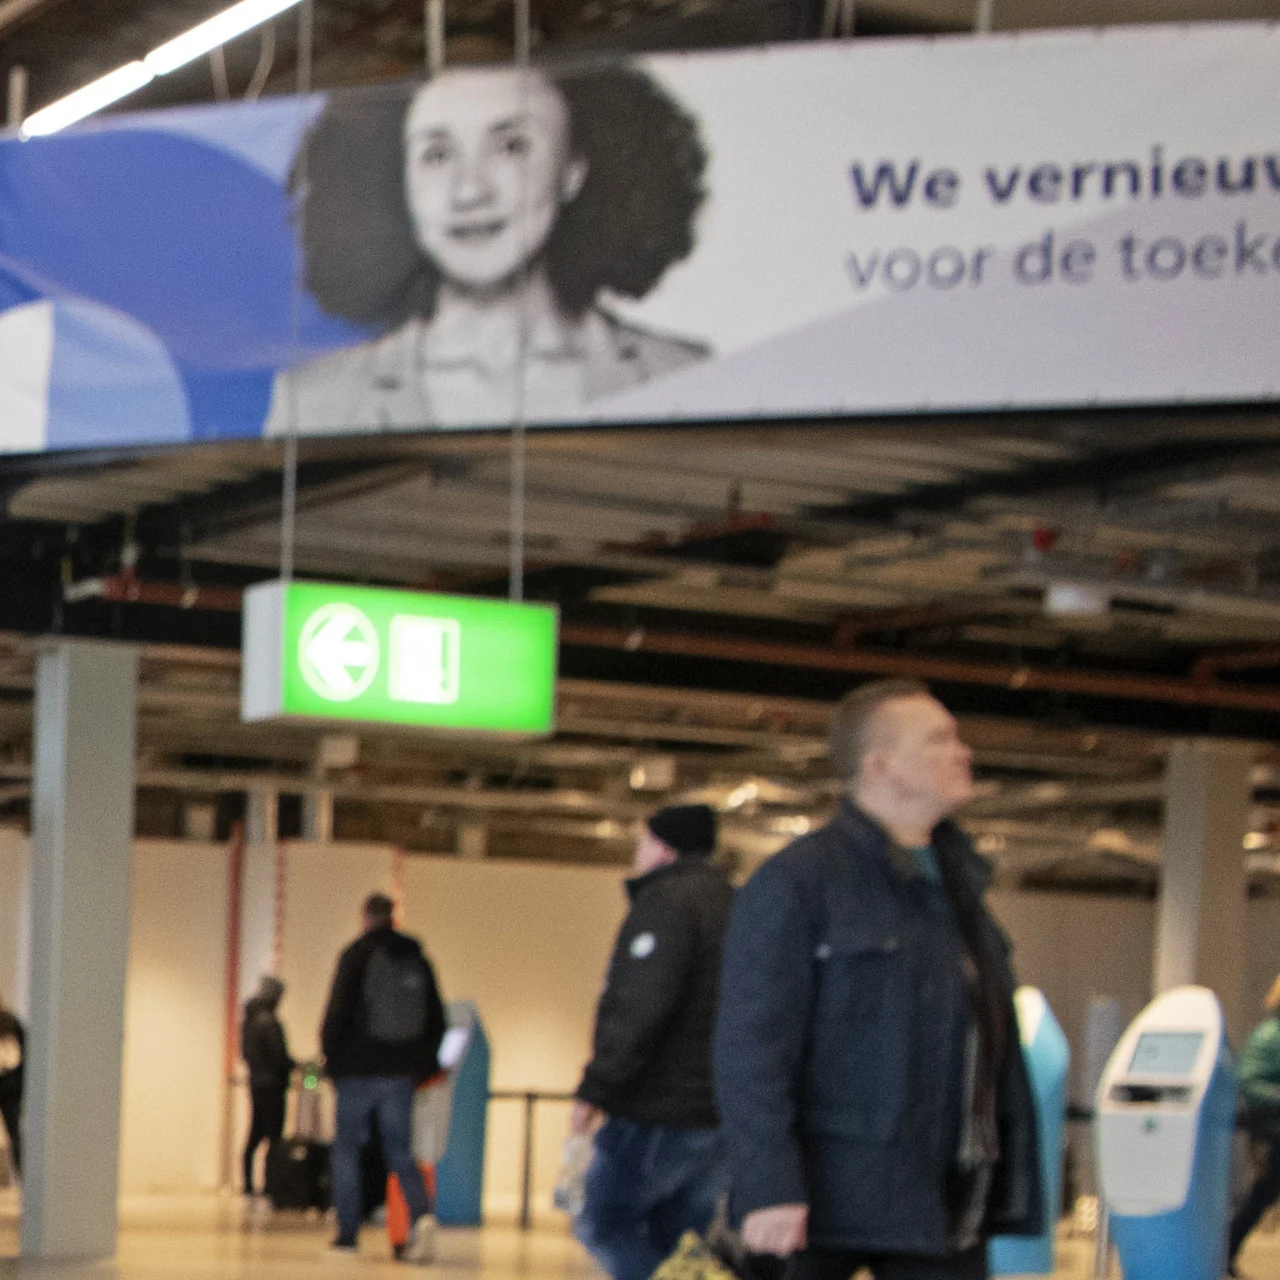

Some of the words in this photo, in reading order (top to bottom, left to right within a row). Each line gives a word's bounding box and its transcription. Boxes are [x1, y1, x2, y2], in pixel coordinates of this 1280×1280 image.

[849, 159, 961, 211] We
[845, 246, 993, 292] voor
[1012, 229, 1097, 286] de
